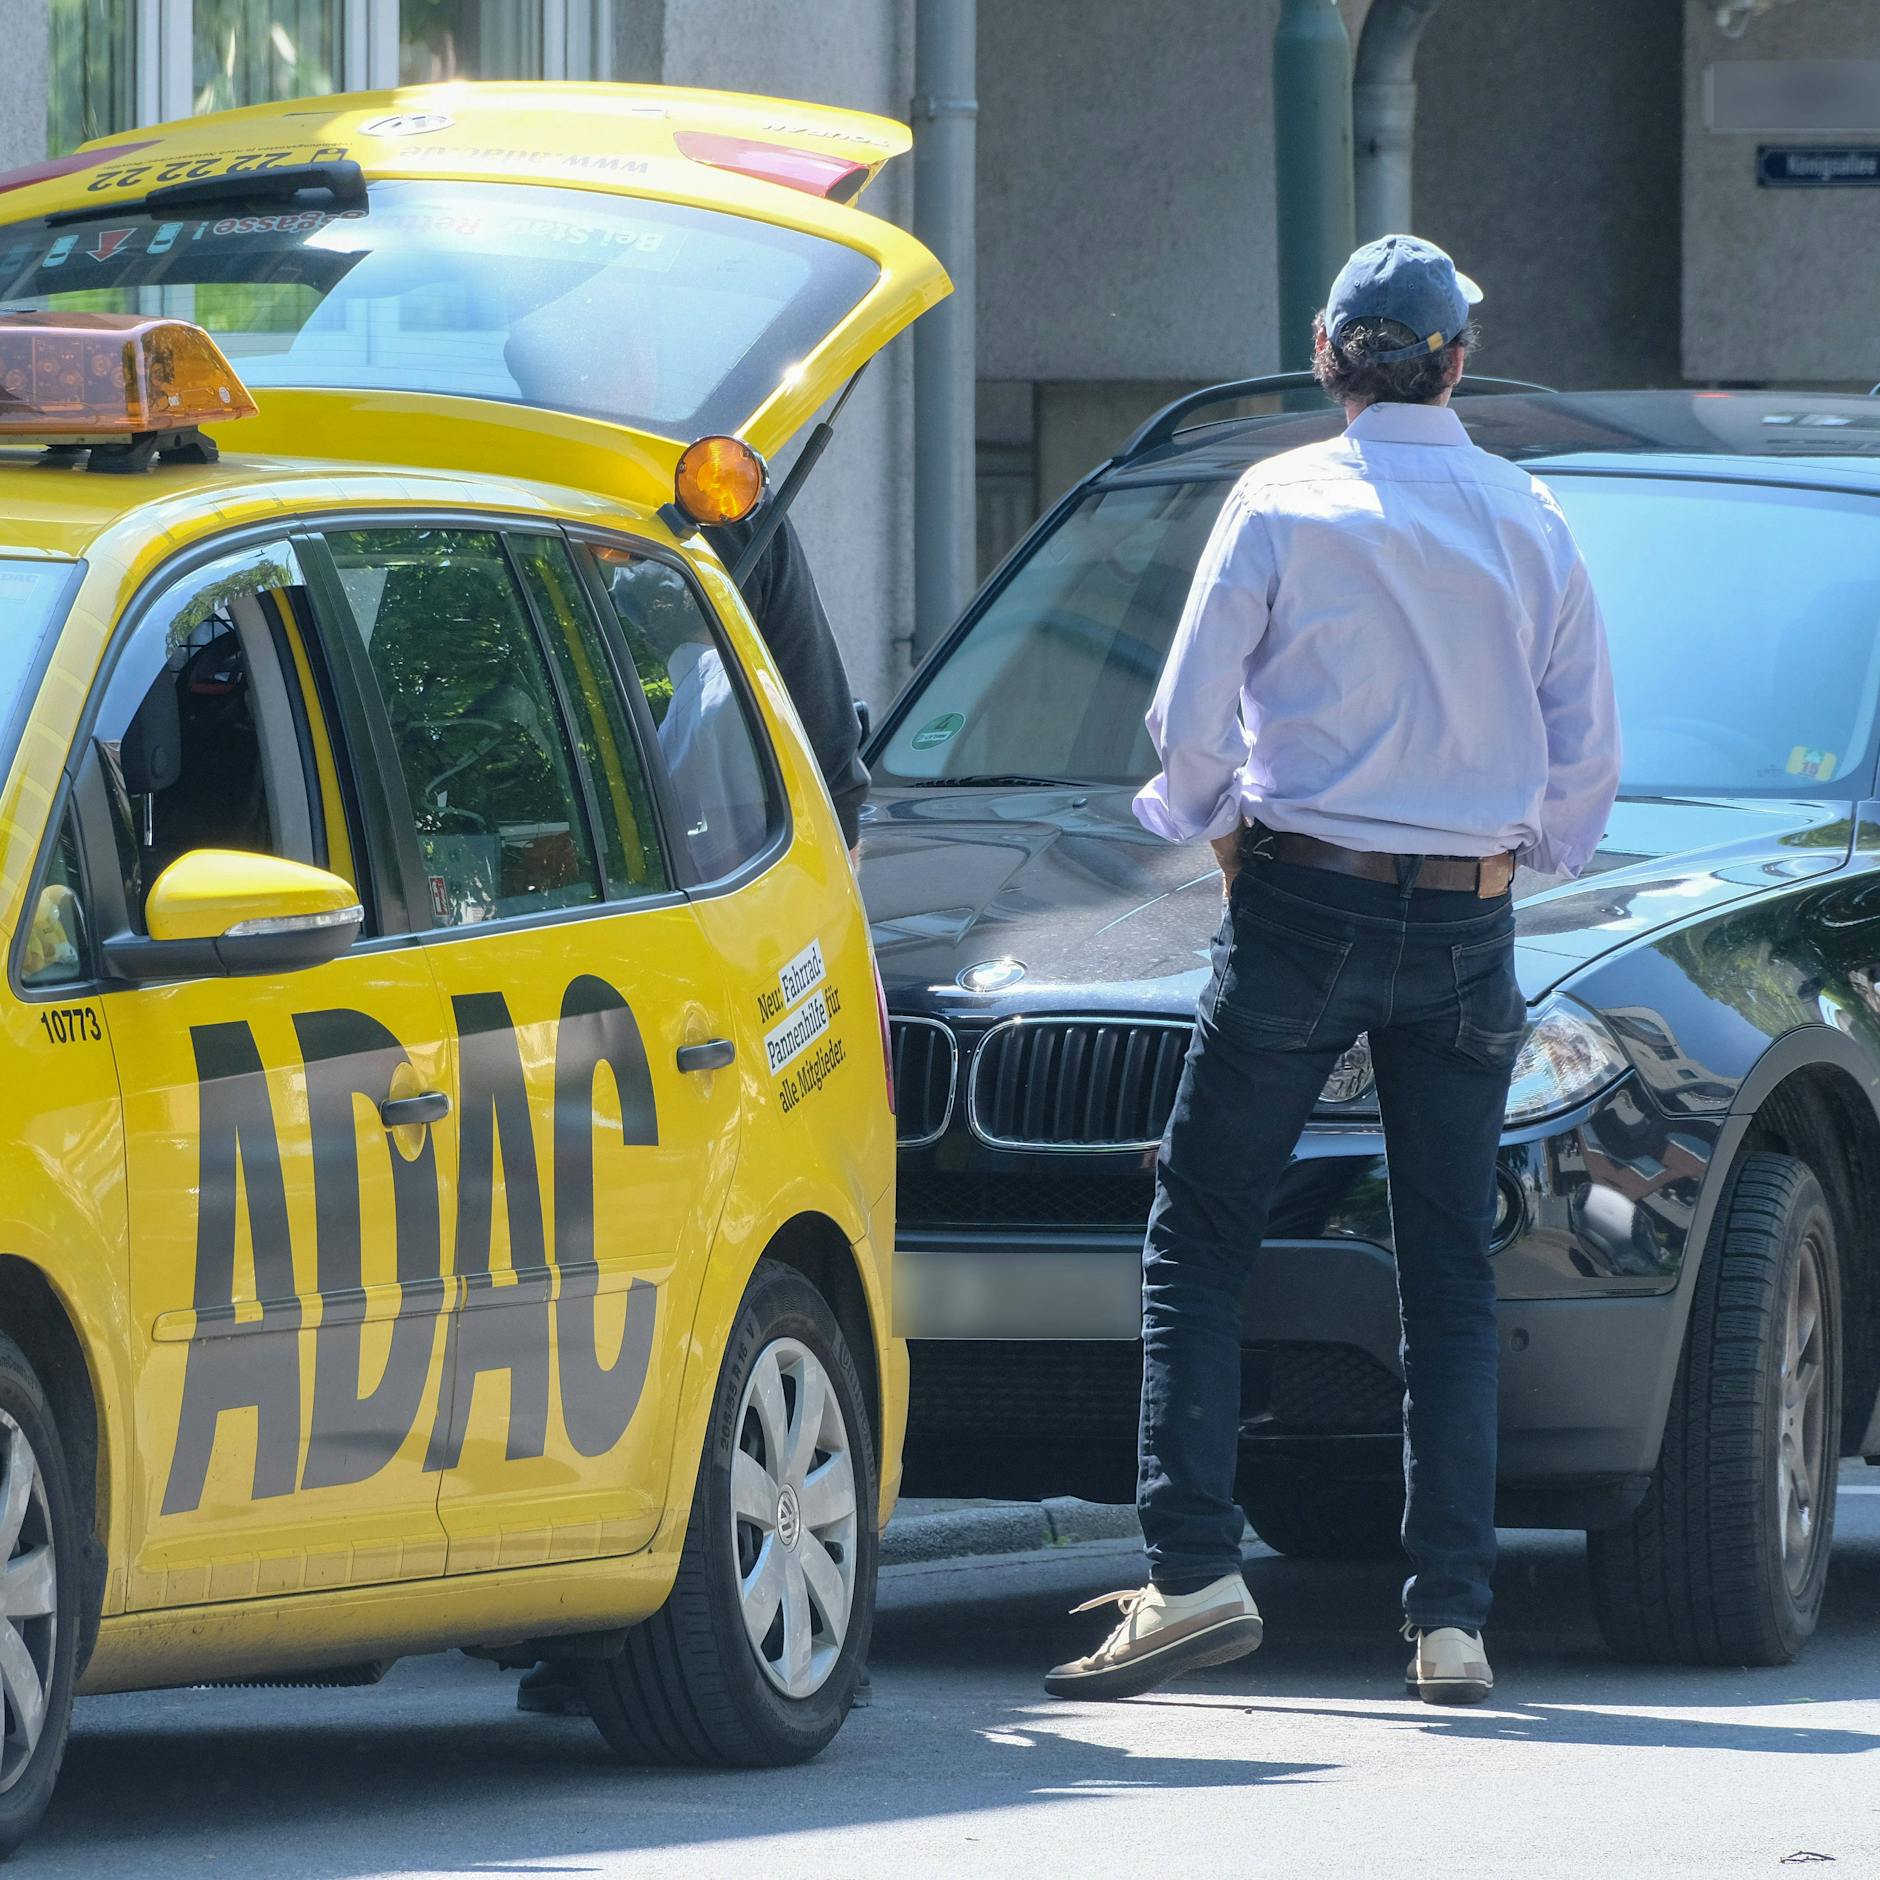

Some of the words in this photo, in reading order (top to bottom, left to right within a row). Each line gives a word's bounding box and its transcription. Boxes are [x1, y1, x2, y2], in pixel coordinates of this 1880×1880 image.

[87, 165, 153, 192] 22
[156, 157, 222, 183] 22
[757, 986, 784, 1024] Neu:
[781, 947, 822, 1003] Fahrrad-
[41, 1007, 102, 1044] 10773
[767, 999, 827, 1069] Pannenhilfe
[825, 985, 841, 1018] für
[779, 1078, 800, 1113] alle
[797, 1038, 847, 1098] Mitglieder.
[160, 974, 659, 1516] ADAC
